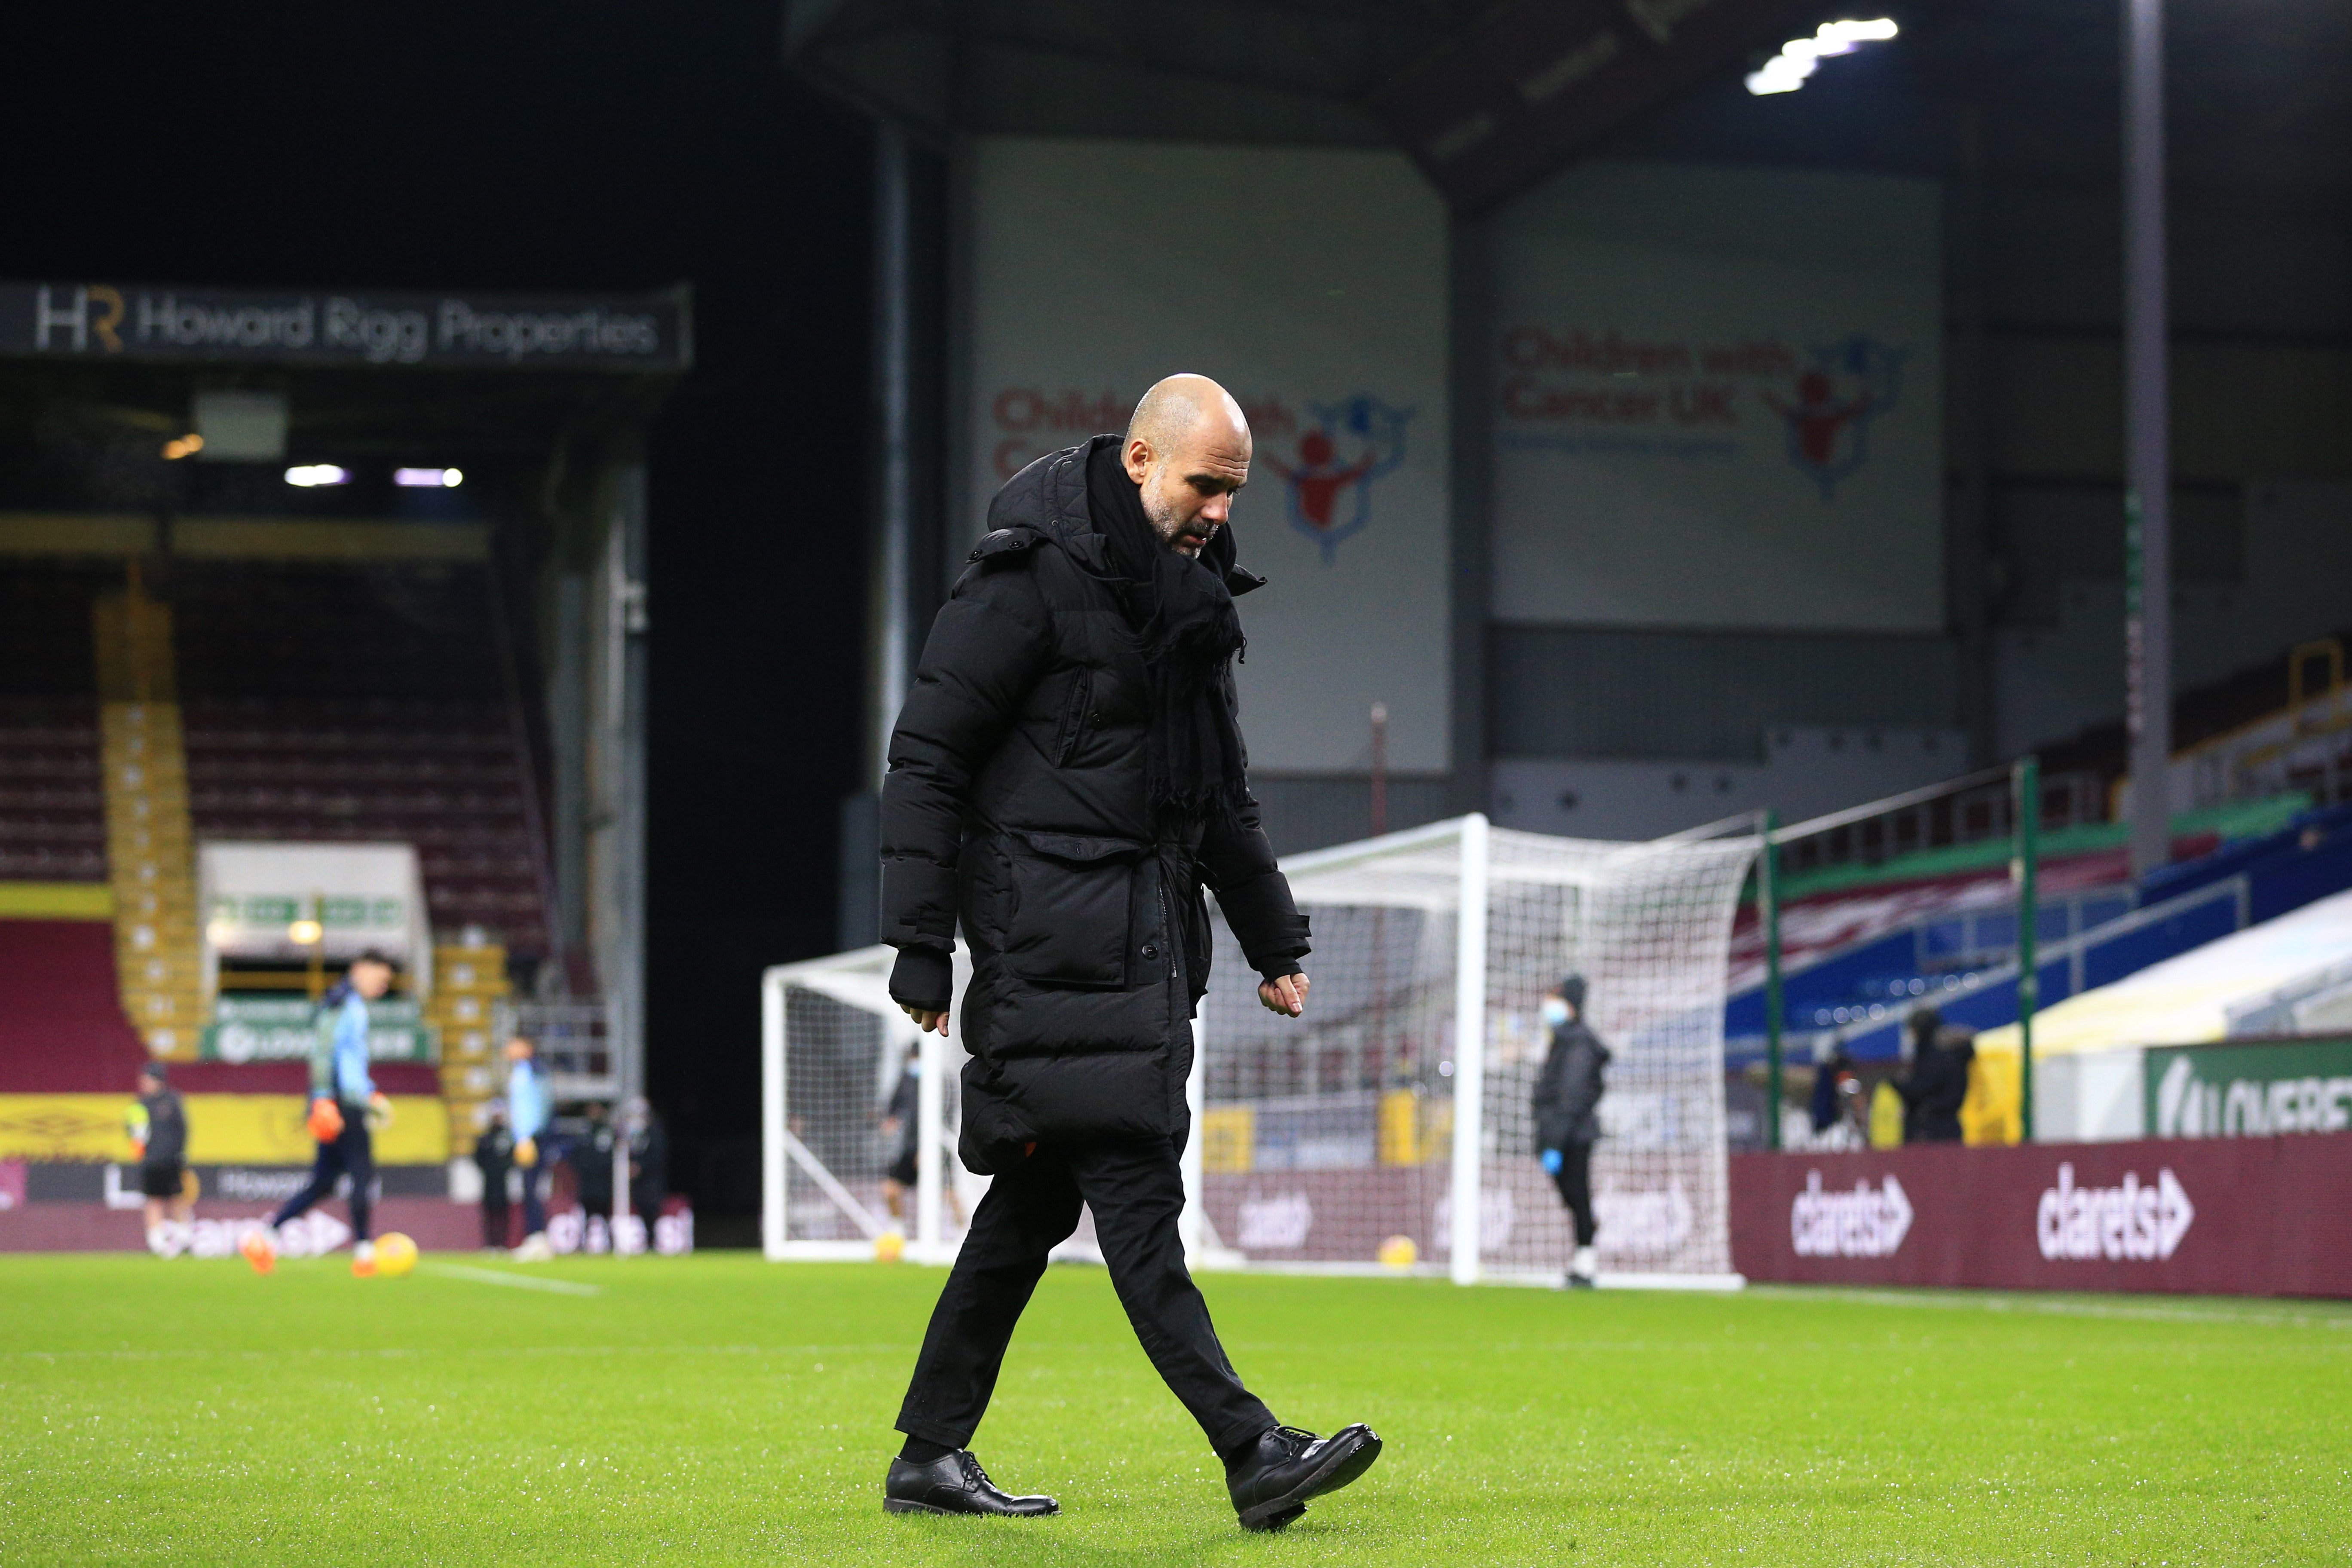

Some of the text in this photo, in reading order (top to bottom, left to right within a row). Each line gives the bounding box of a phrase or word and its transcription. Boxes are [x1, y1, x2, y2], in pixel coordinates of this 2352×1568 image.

[137, 293, 658, 364] Howard Rigg Properties
[1503, 323, 1690, 371] Children
[1669, 382, 1739, 427] UK
[1791, 1168, 1883, 1258] clarets
[2037, 1161, 2158, 1261] clarets
